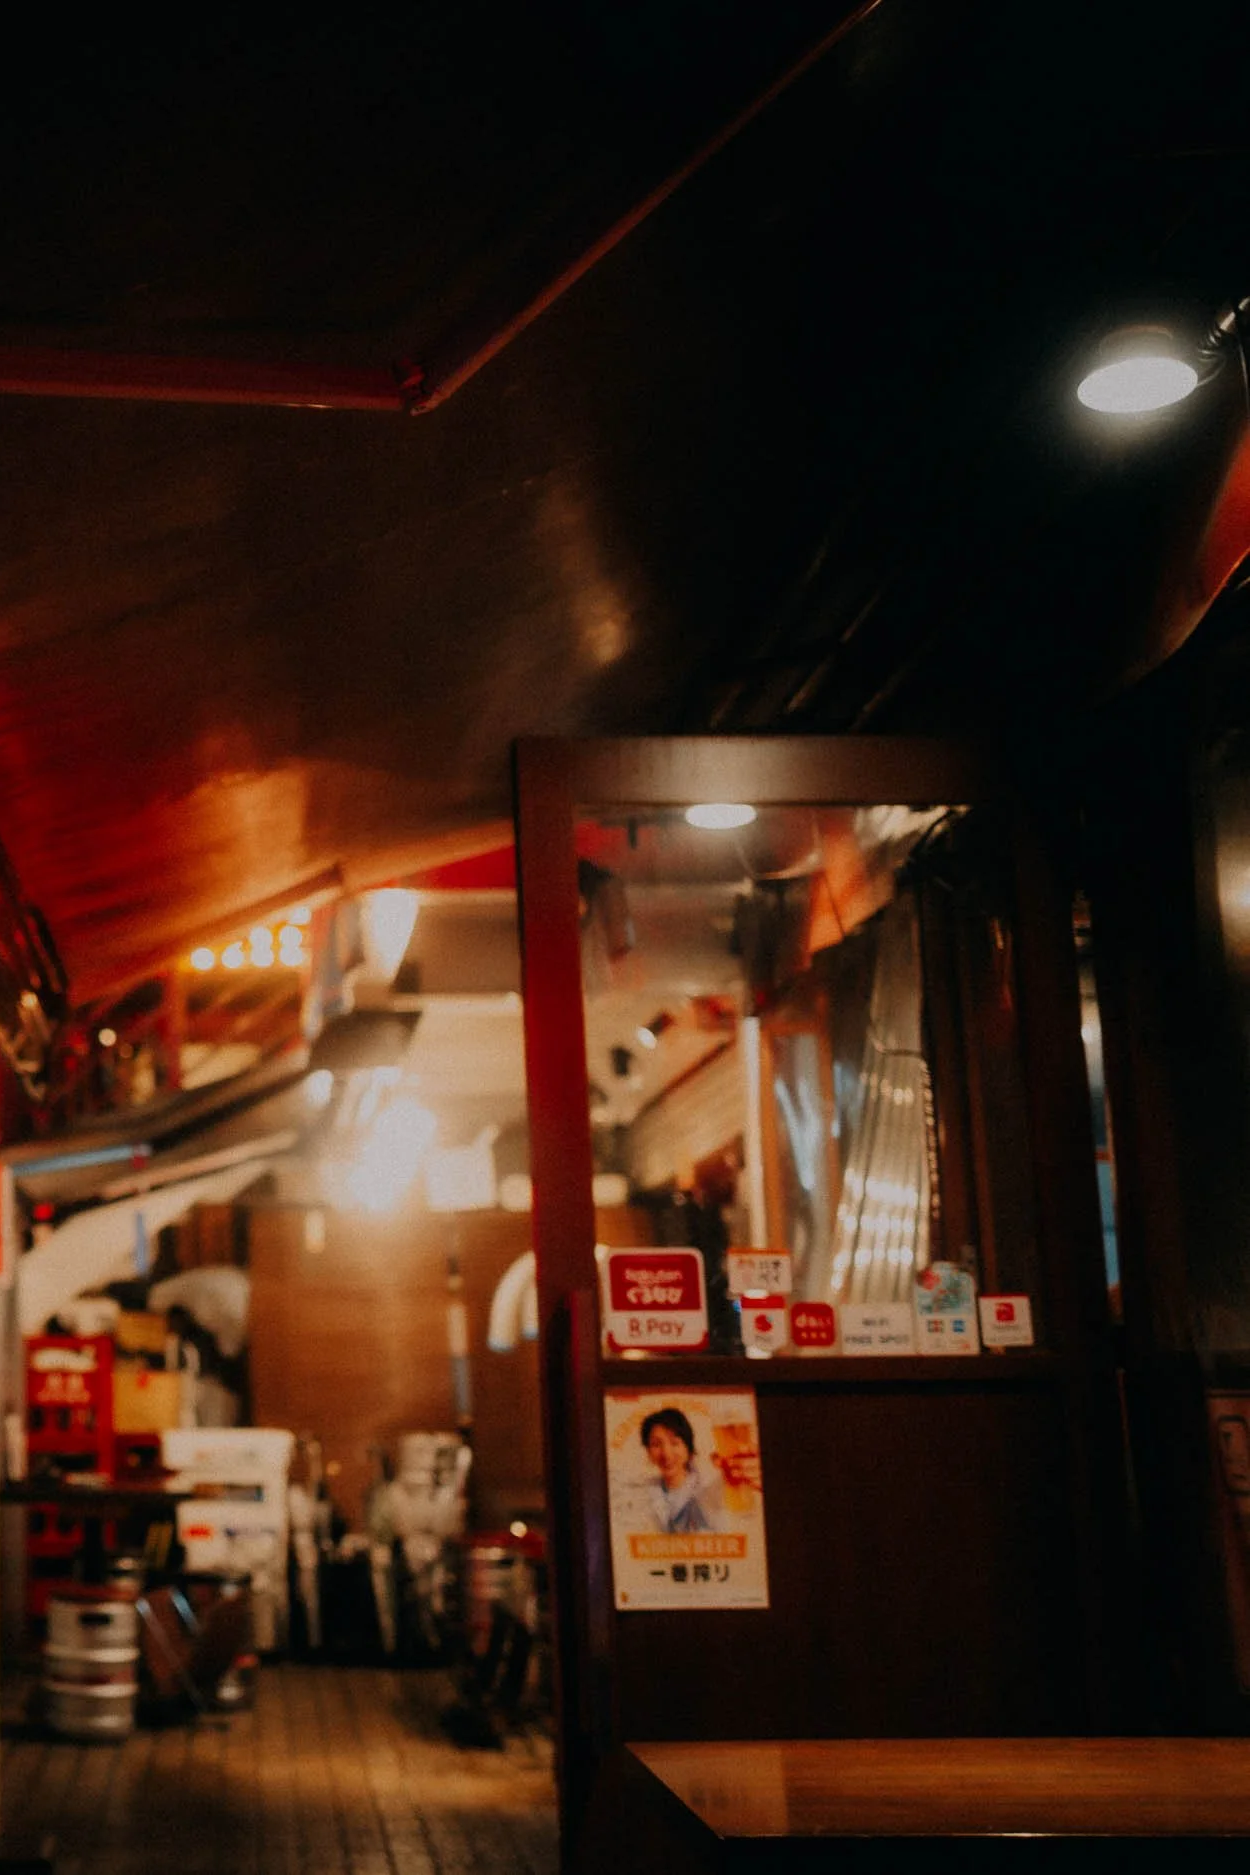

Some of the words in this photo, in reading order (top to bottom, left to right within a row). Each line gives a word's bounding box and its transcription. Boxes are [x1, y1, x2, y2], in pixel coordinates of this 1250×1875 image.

[647, 1318, 685, 1338] Pay
[694, 1537, 740, 1553] BEER
[648, 1562, 731, 1584] 一番搾り
